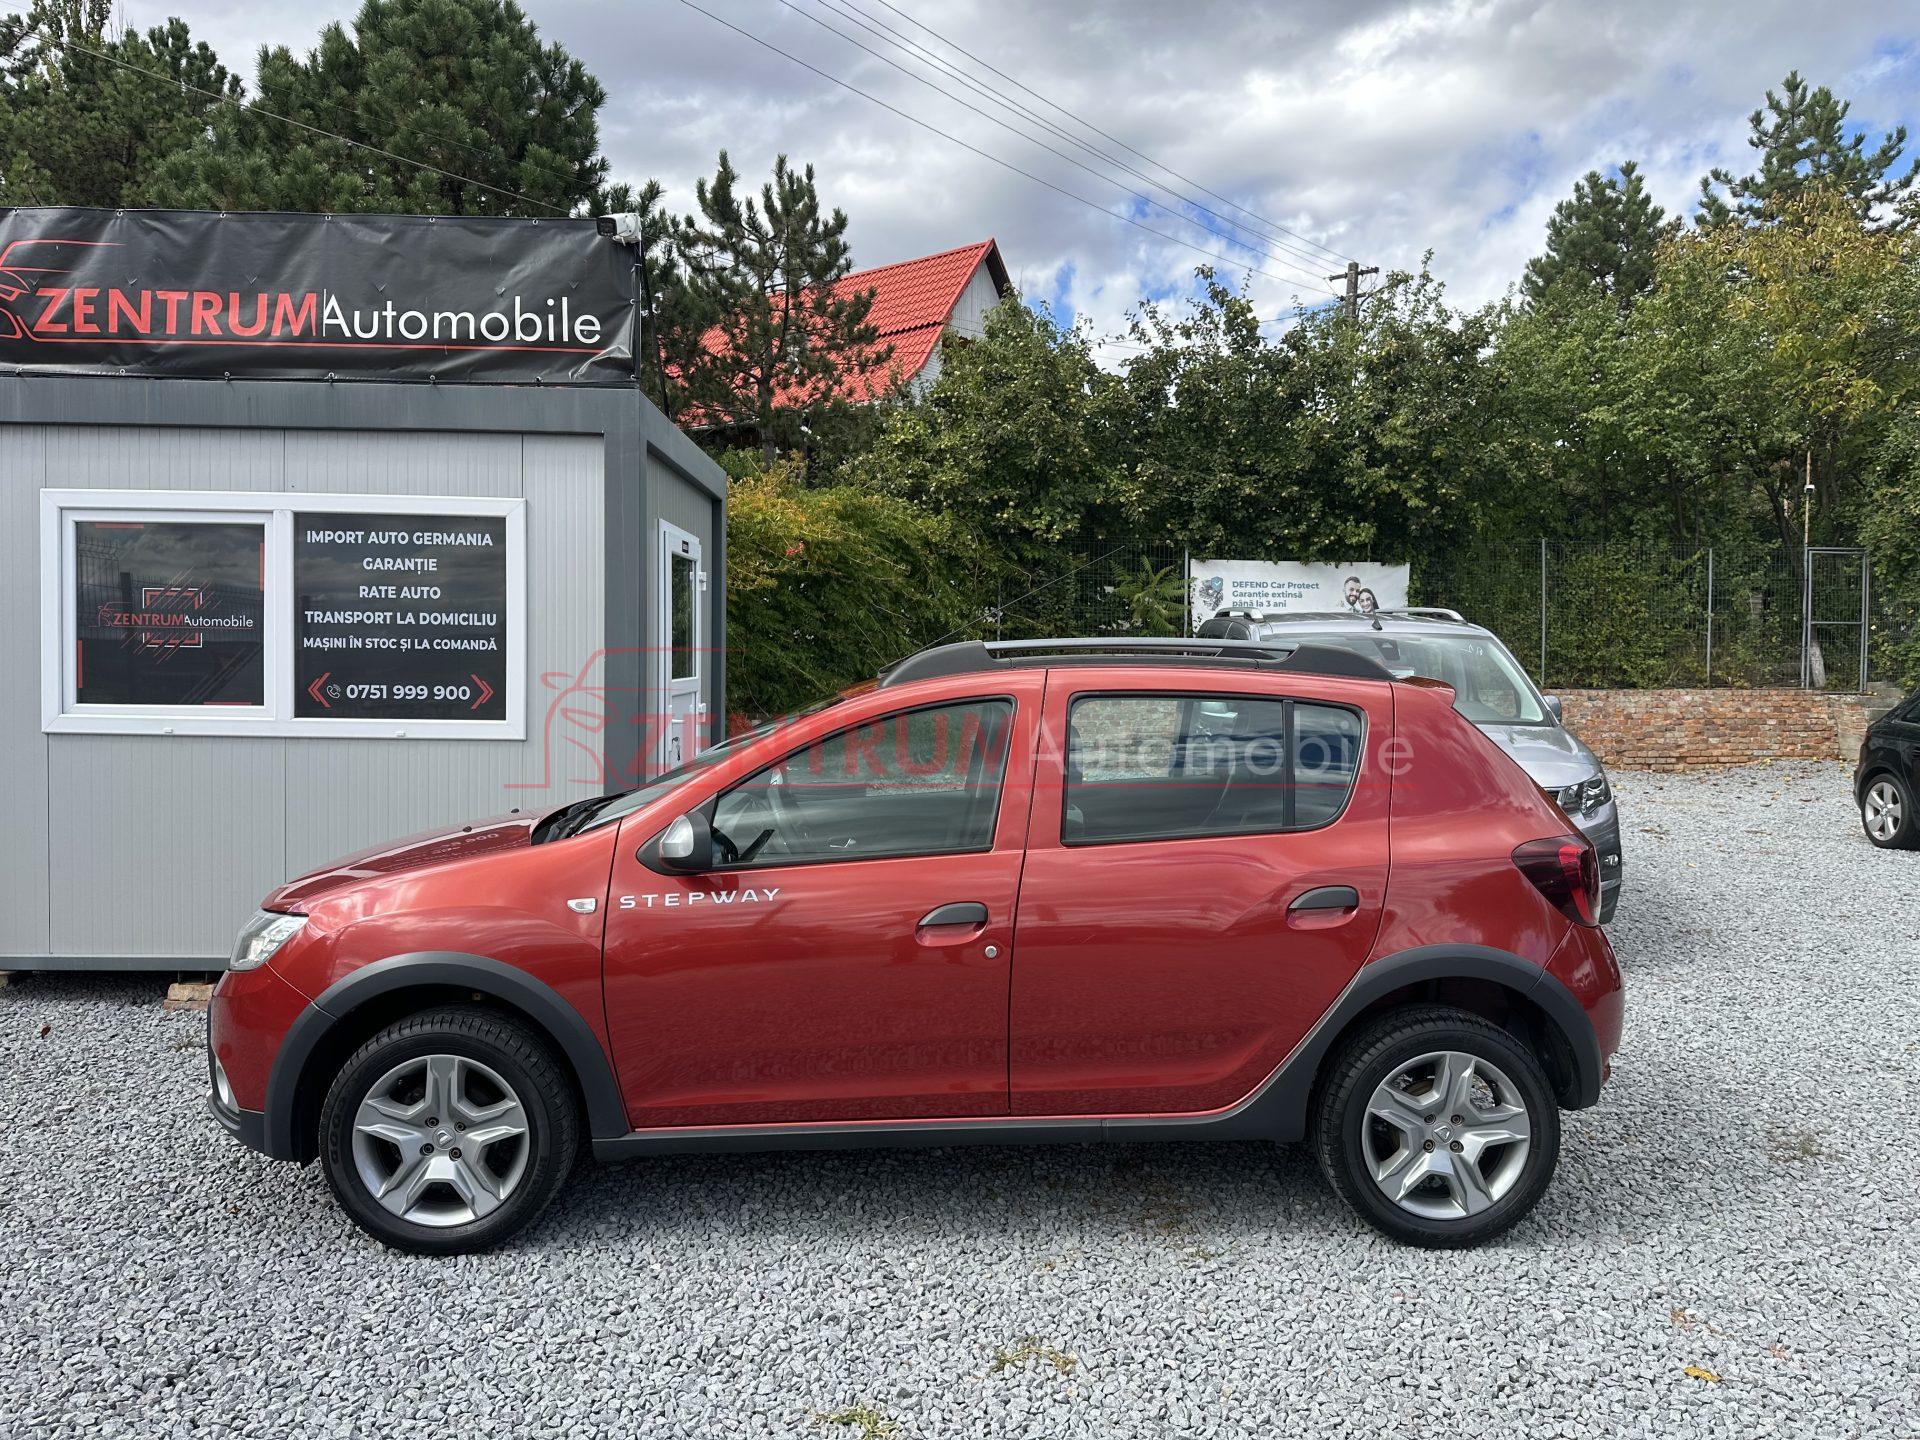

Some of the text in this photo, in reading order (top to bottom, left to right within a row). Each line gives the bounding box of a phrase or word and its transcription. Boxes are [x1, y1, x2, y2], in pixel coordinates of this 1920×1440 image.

[33, 288, 601, 344] ZENTRUM Automobile
[307, 531, 493, 546] IMPORT AUTO GERMANIA
[363, 558, 437, 574] GARANȚIE
[360, 586, 441, 599] RATE AUTO
[1288, 582, 1319, 590] Protect
[1232, 590, 1303, 599] Garanție extinsă
[1256, 600, 1264, 608] la
[1266, 600, 1272, 608] 3
[1273, 600, 1287, 608] ani
[113, 613, 253, 627] ZENTRUM Automobile
[305, 611, 496, 626] TRANSPORT LA DOMICILIU
[304, 635, 497, 652] MAȘINI ÎN STOC ȘI LA COMANDĂ
[347, 685, 470, 700] 0751 999 900
[619, 888, 782, 909] STEPWAY
